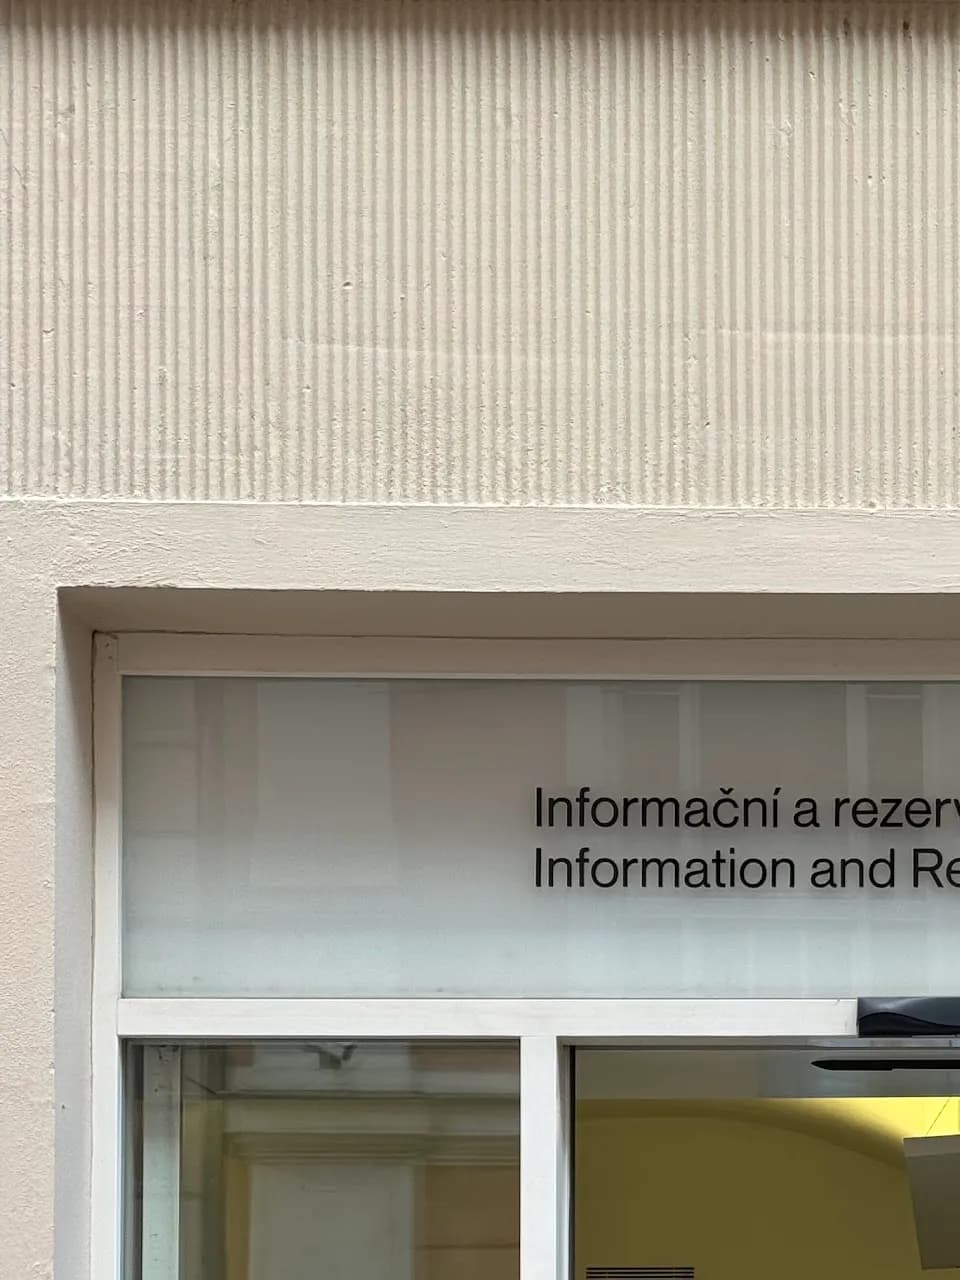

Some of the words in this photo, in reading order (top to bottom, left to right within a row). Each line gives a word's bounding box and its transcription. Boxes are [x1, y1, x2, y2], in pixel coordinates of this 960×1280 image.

[535, 786, 782, 828] Informační
[793, 797, 821, 828] a
[535, 847, 796, 889] Information
[810, 848, 895, 888] and
